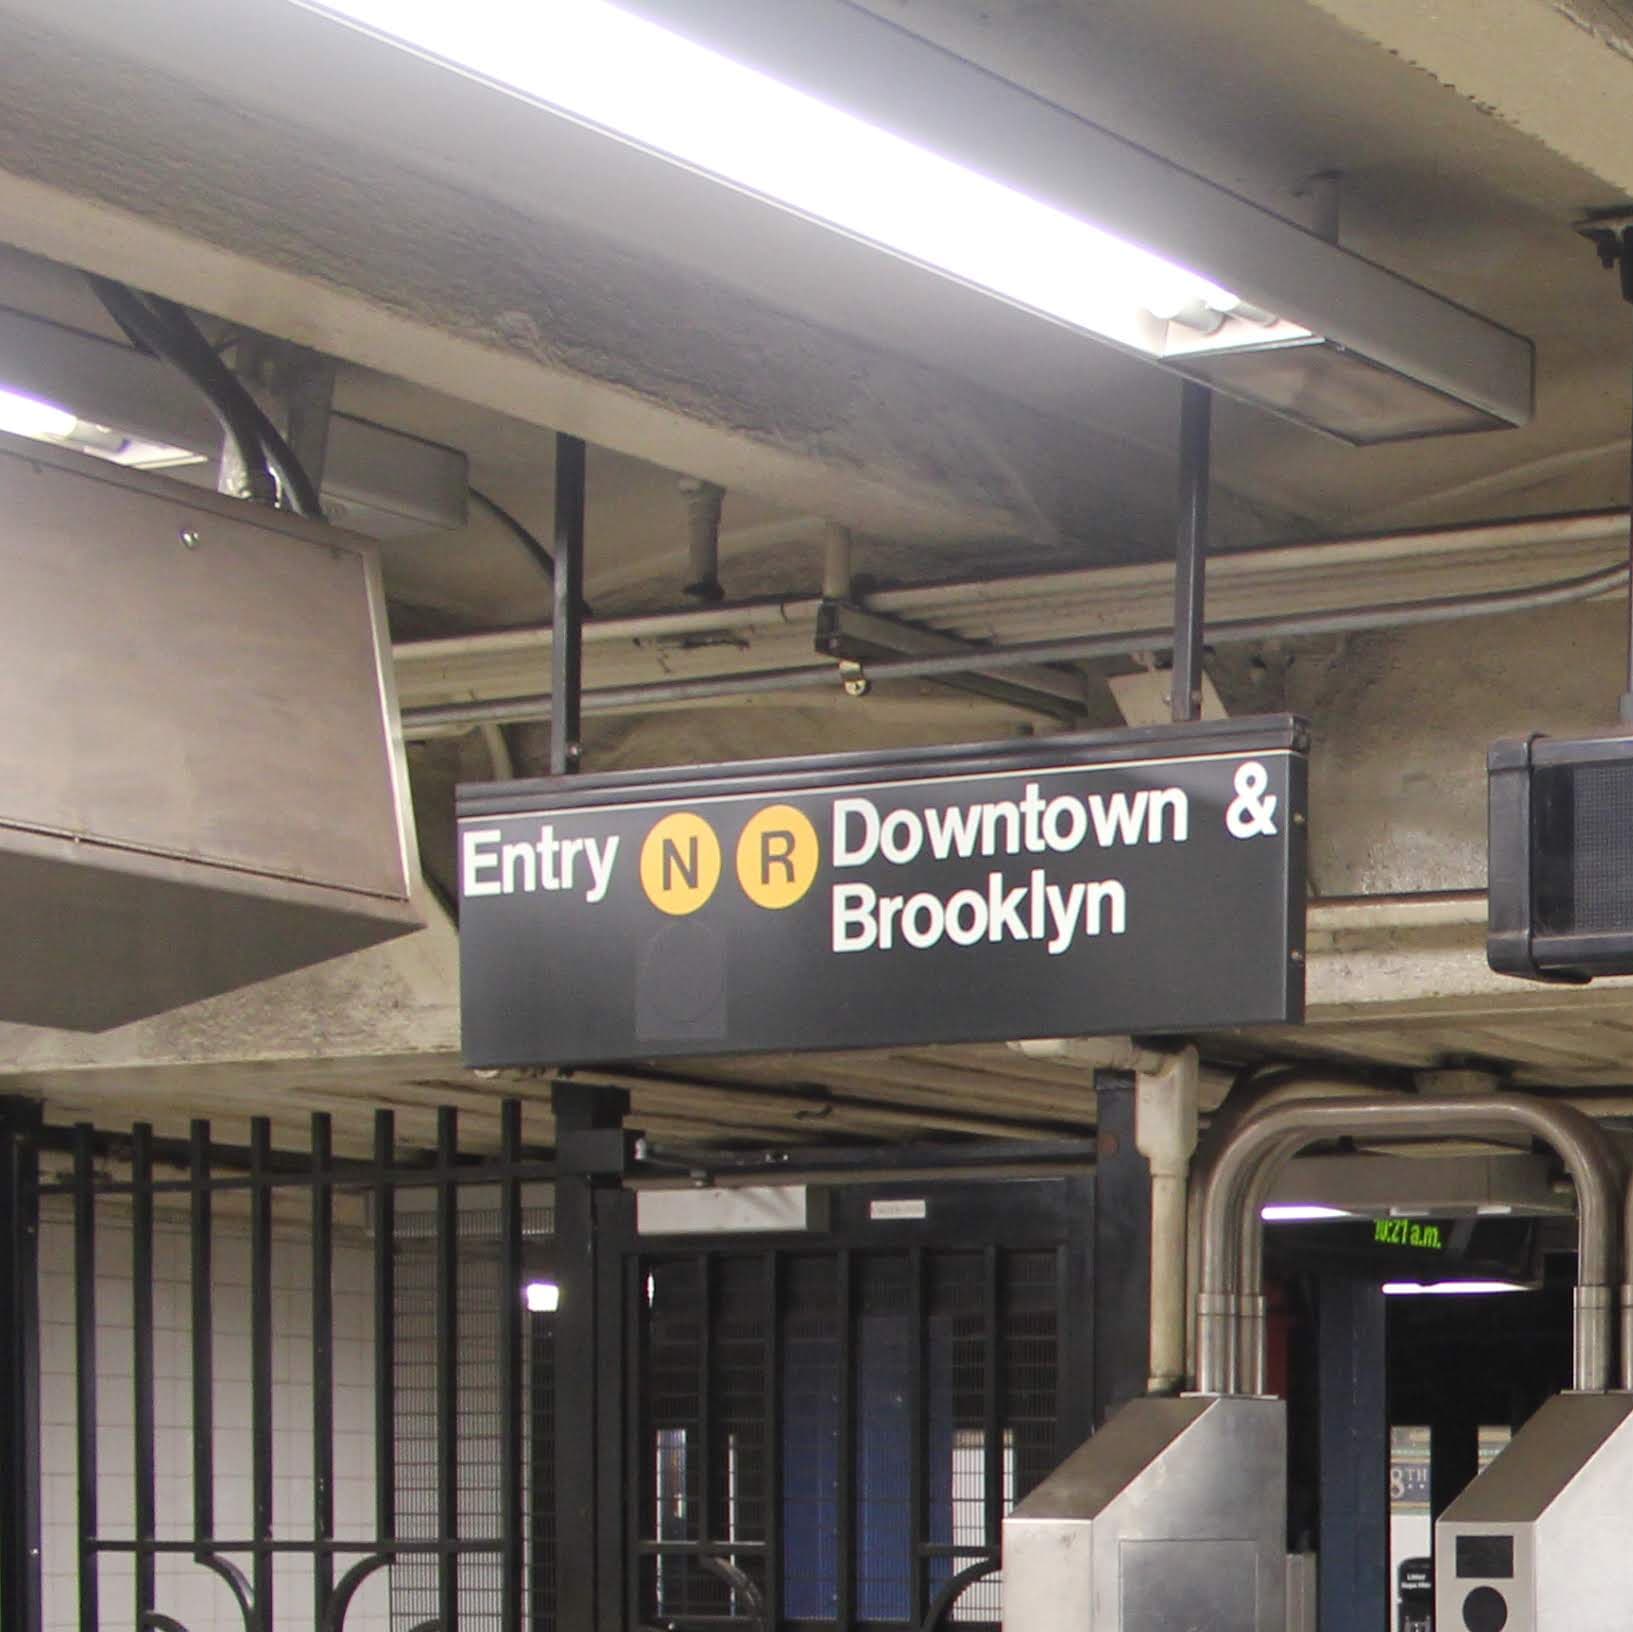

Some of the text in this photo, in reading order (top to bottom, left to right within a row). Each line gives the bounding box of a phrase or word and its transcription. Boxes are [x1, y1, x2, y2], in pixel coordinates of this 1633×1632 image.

[461, 761, 1278, 904] Entry N R Downtown &
[832, 868, 1127, 955] Brooklyn
